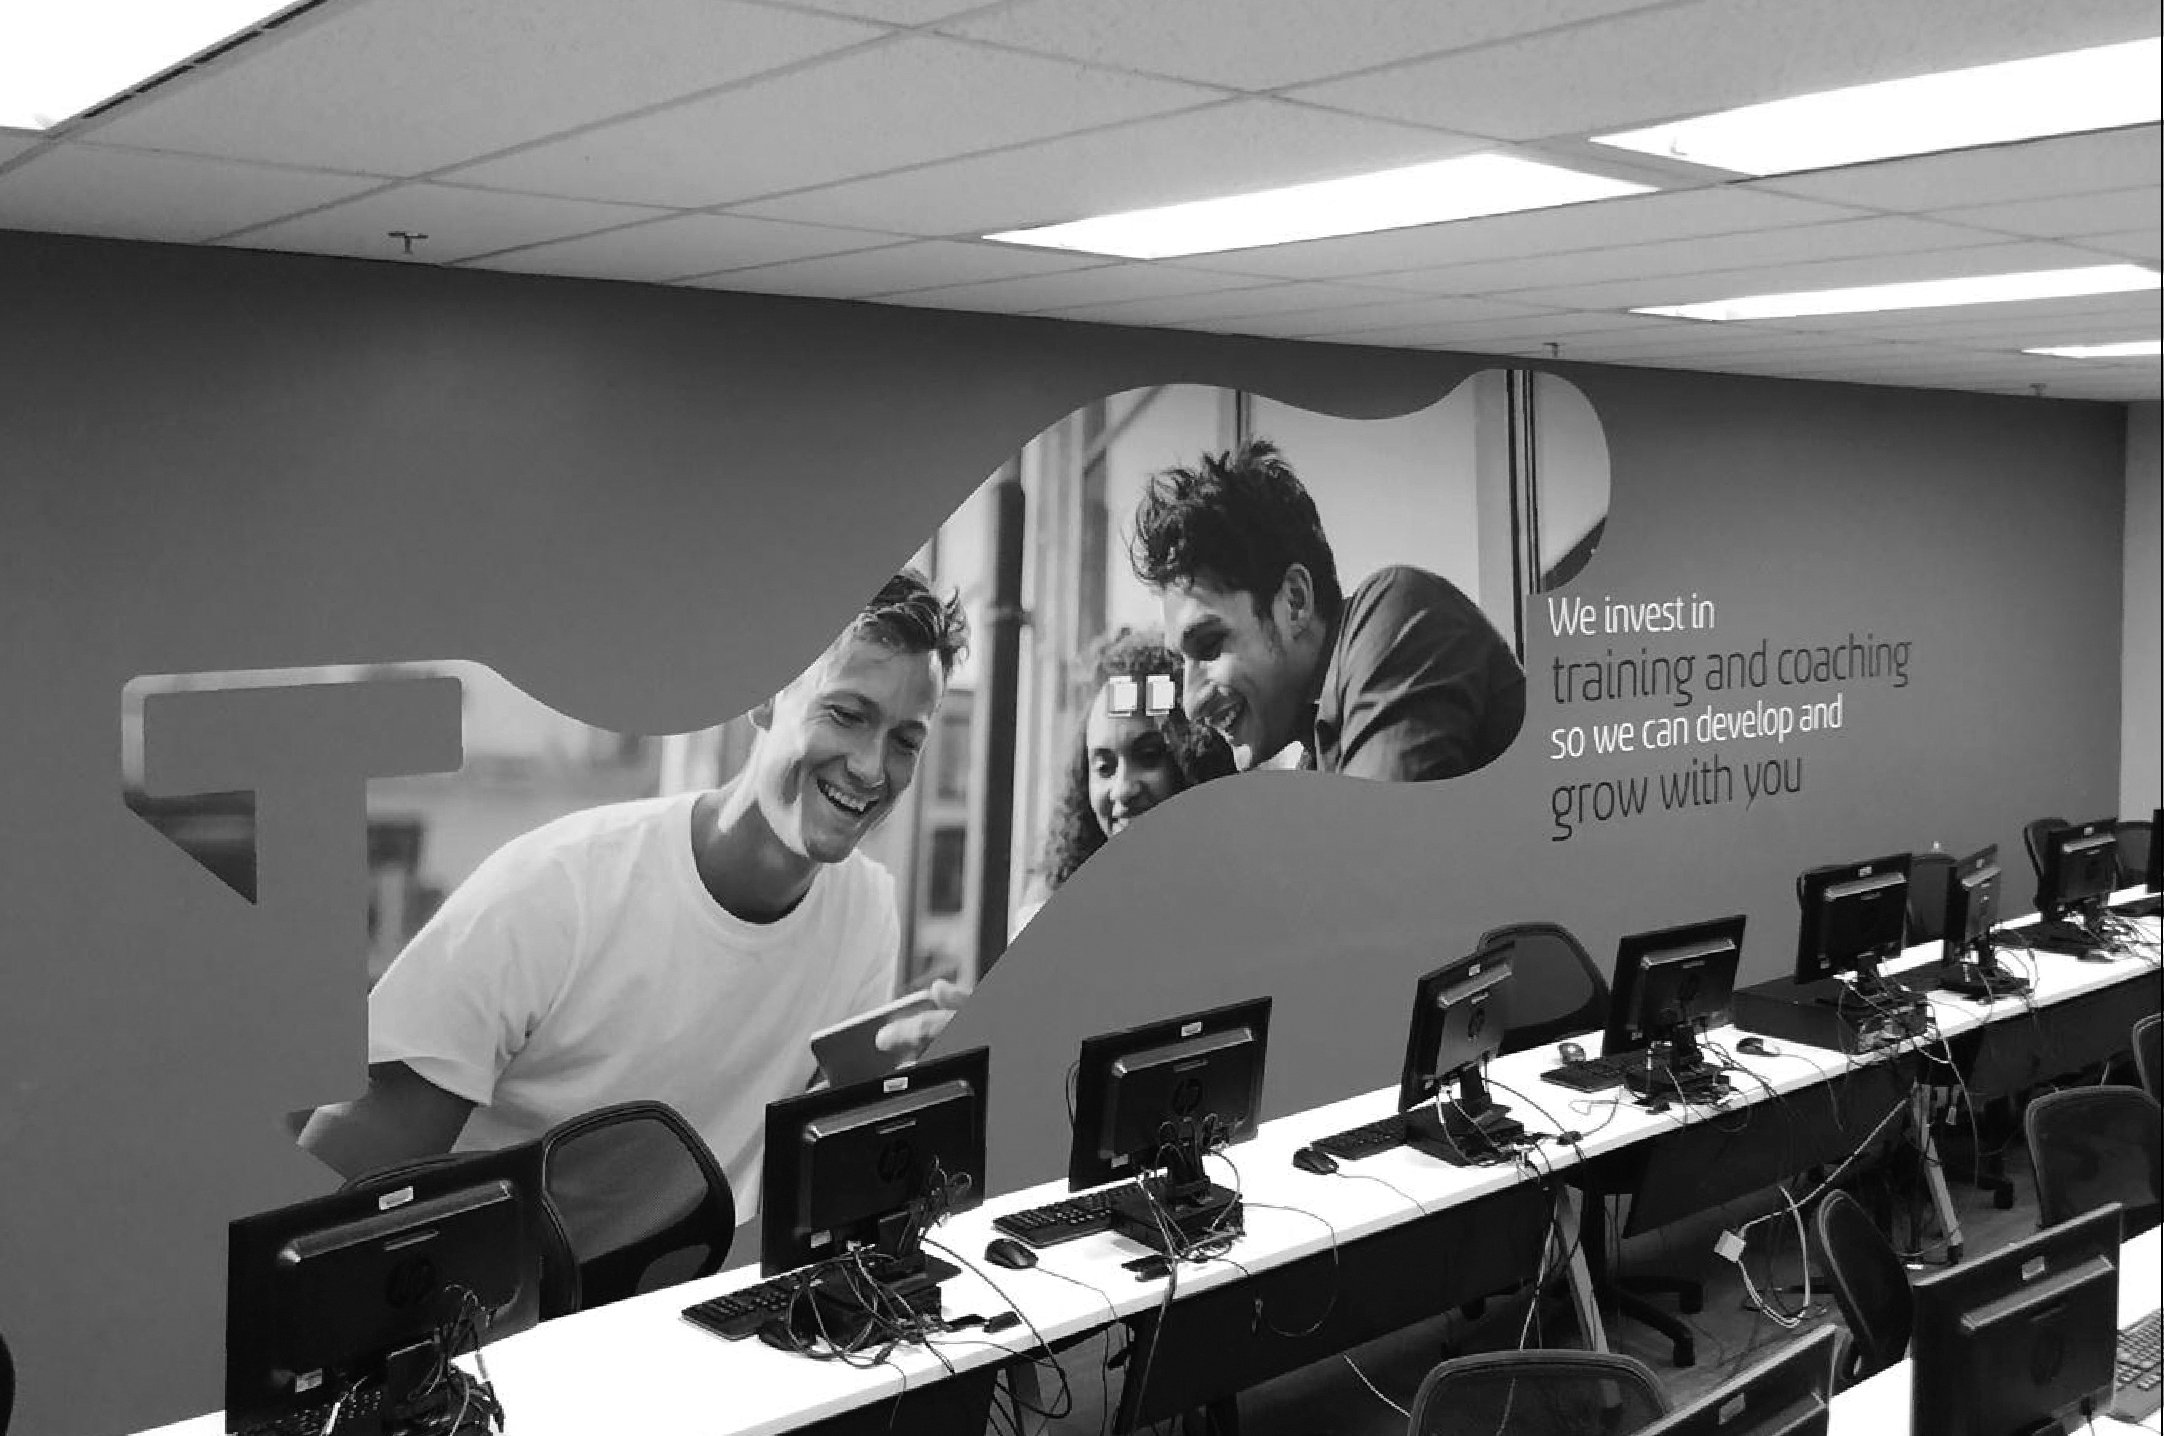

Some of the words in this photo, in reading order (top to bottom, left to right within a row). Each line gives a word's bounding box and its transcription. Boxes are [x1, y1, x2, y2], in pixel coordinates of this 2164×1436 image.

[1547, 596, 1597, 638] We
[1604, 595, 1686, 634] invest
[1692, 592, 1715, 629] in
[1552, 647, 1696, 708] training
[1705, 638, 1768, 691] and
[1777, 632, 1913, 689] coaching
[1550, 726, 1586, 760] so
[1593, 722, 1635, 754] we
[1641, 717, 1688, 749] can
[1695, 699, 1793, 744] develop
[1799, 692, 1843, 733] and
[1551, 776, 1648, 843] grow
[1659, 753, 1733, 811] with
[1743, 756, 1803, 811] you
